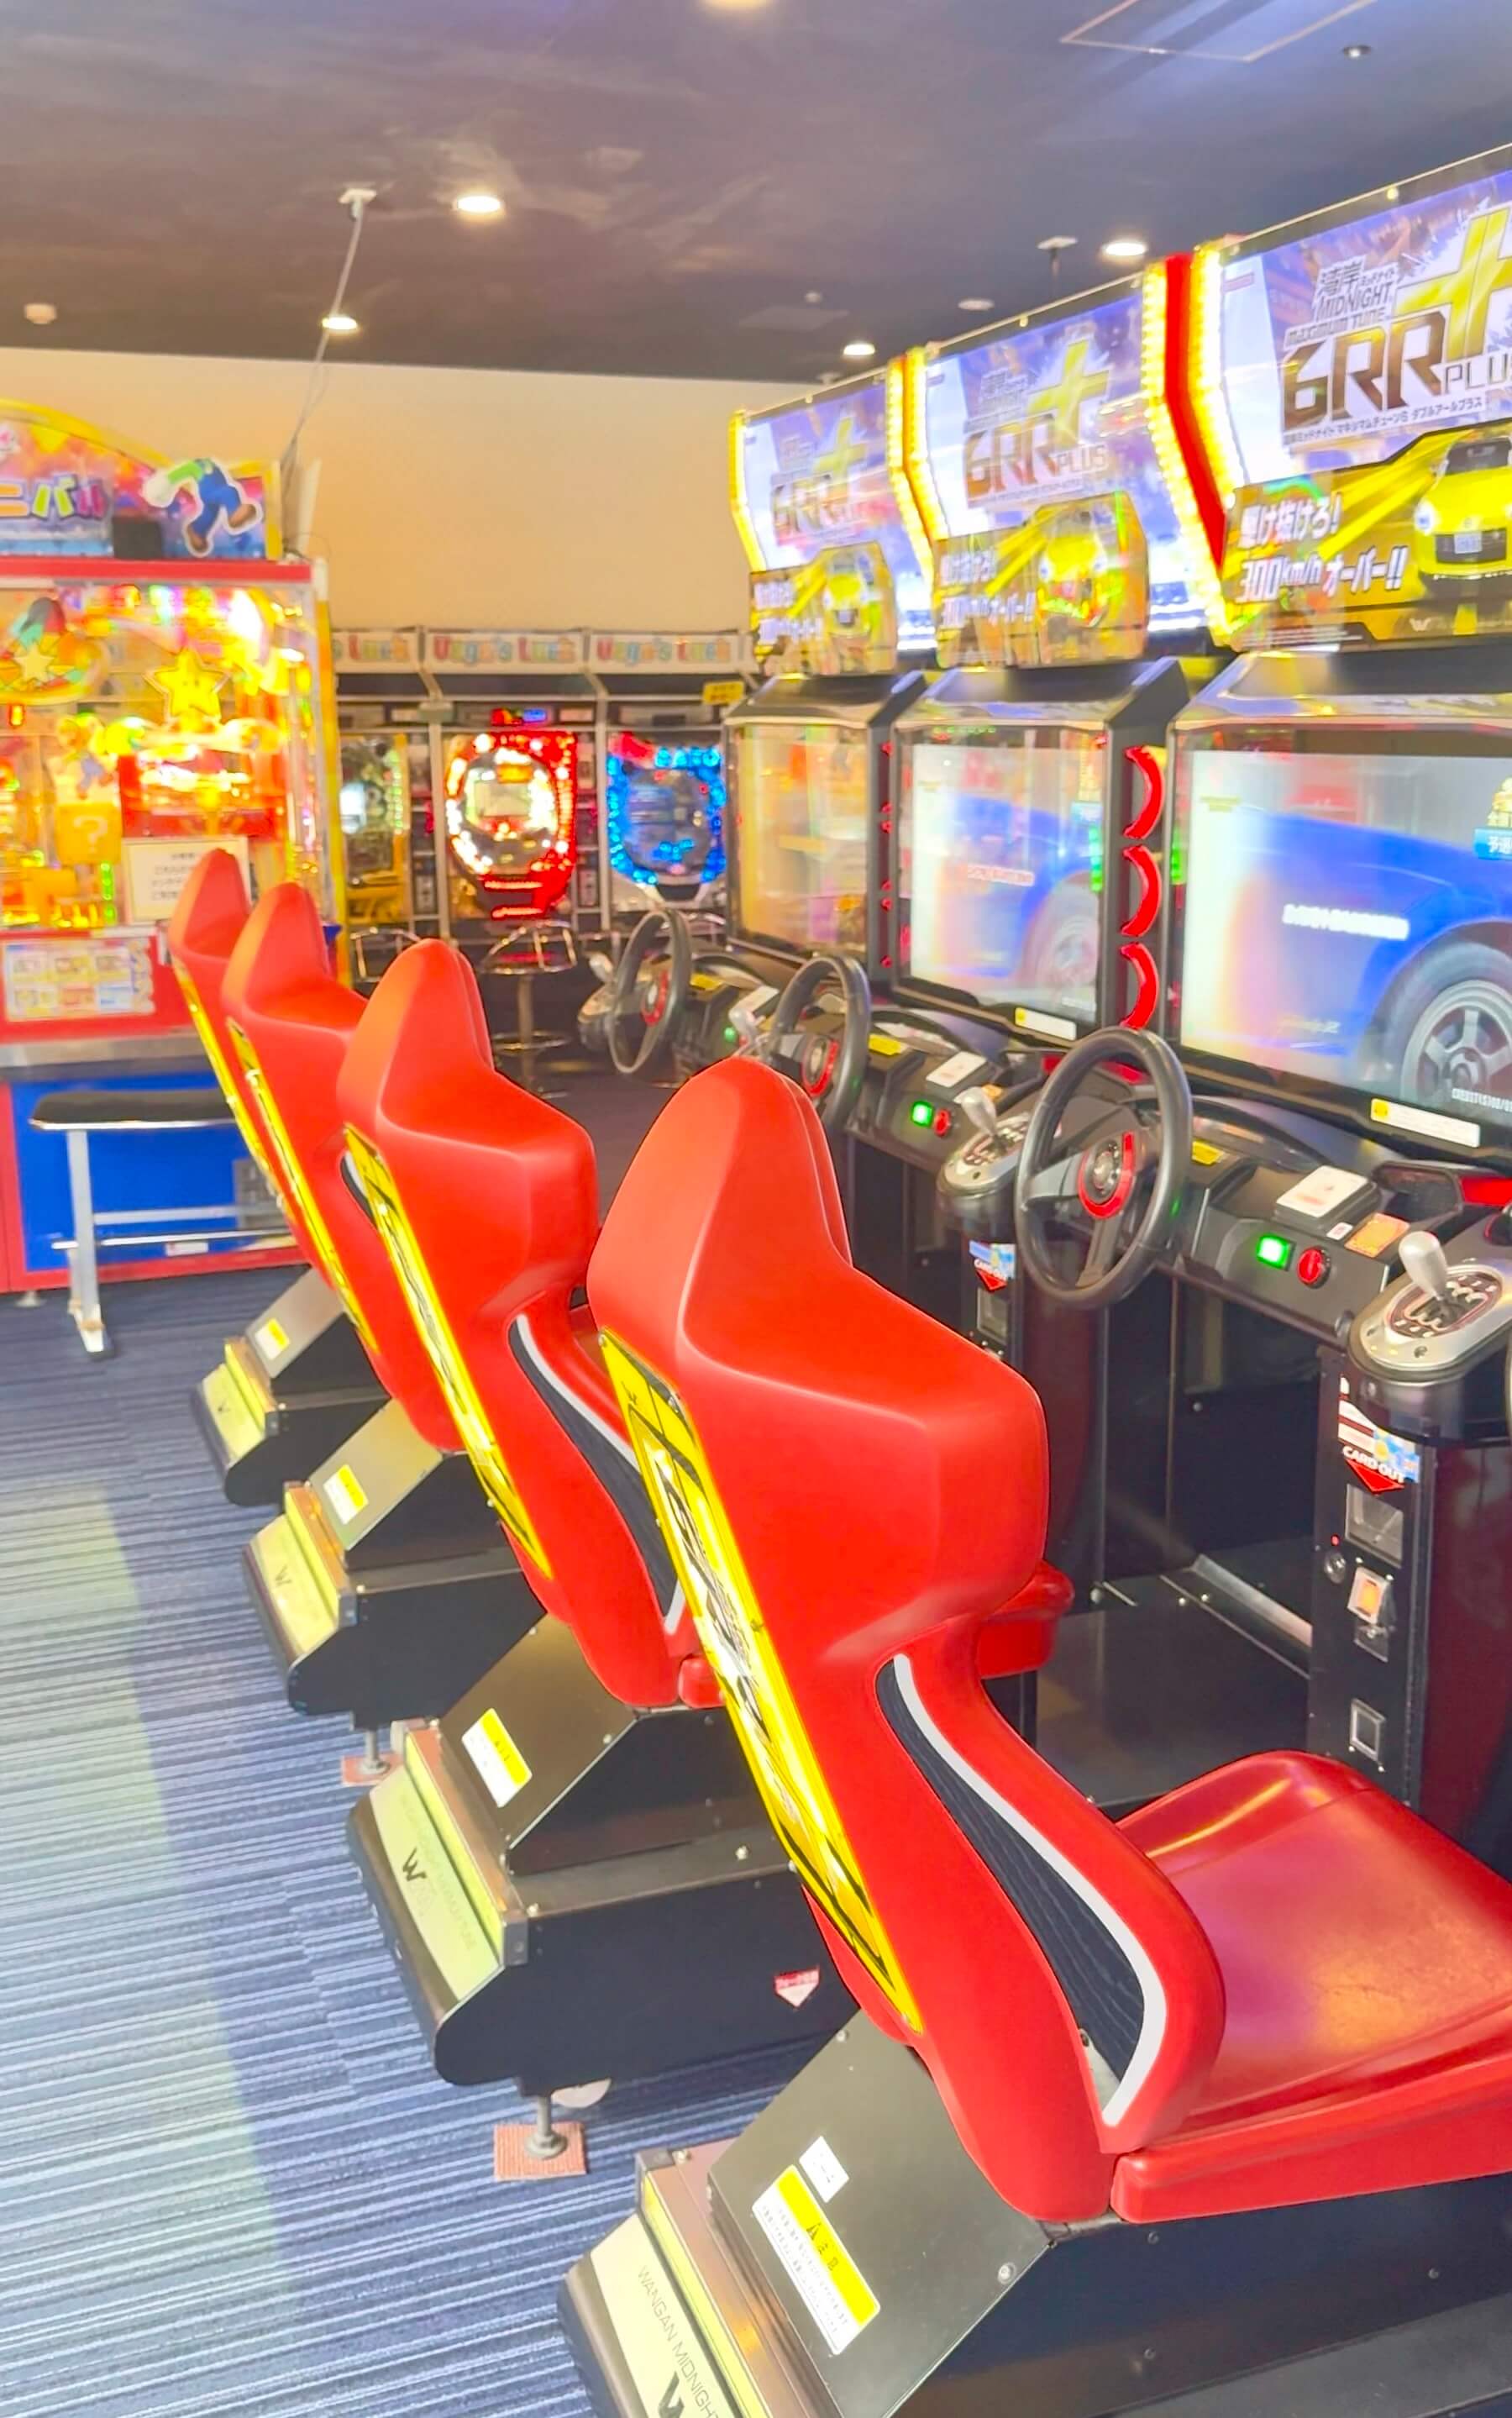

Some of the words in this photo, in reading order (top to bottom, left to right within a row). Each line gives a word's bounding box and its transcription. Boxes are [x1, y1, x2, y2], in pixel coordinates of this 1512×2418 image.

[1316, 281, 1393, 321] MIDNIGHT
[1284, 311, 1446, 430] 6RR
[1445, 353, 1512, 394] PLU
[1342, 1446, 1378, 1470] CARD
[1378, 1464, 1404, 1483] OUT
[638, 2265, 678, 2342] WANGAN
[672, 2341, 720, 2418] MIDNIGH
